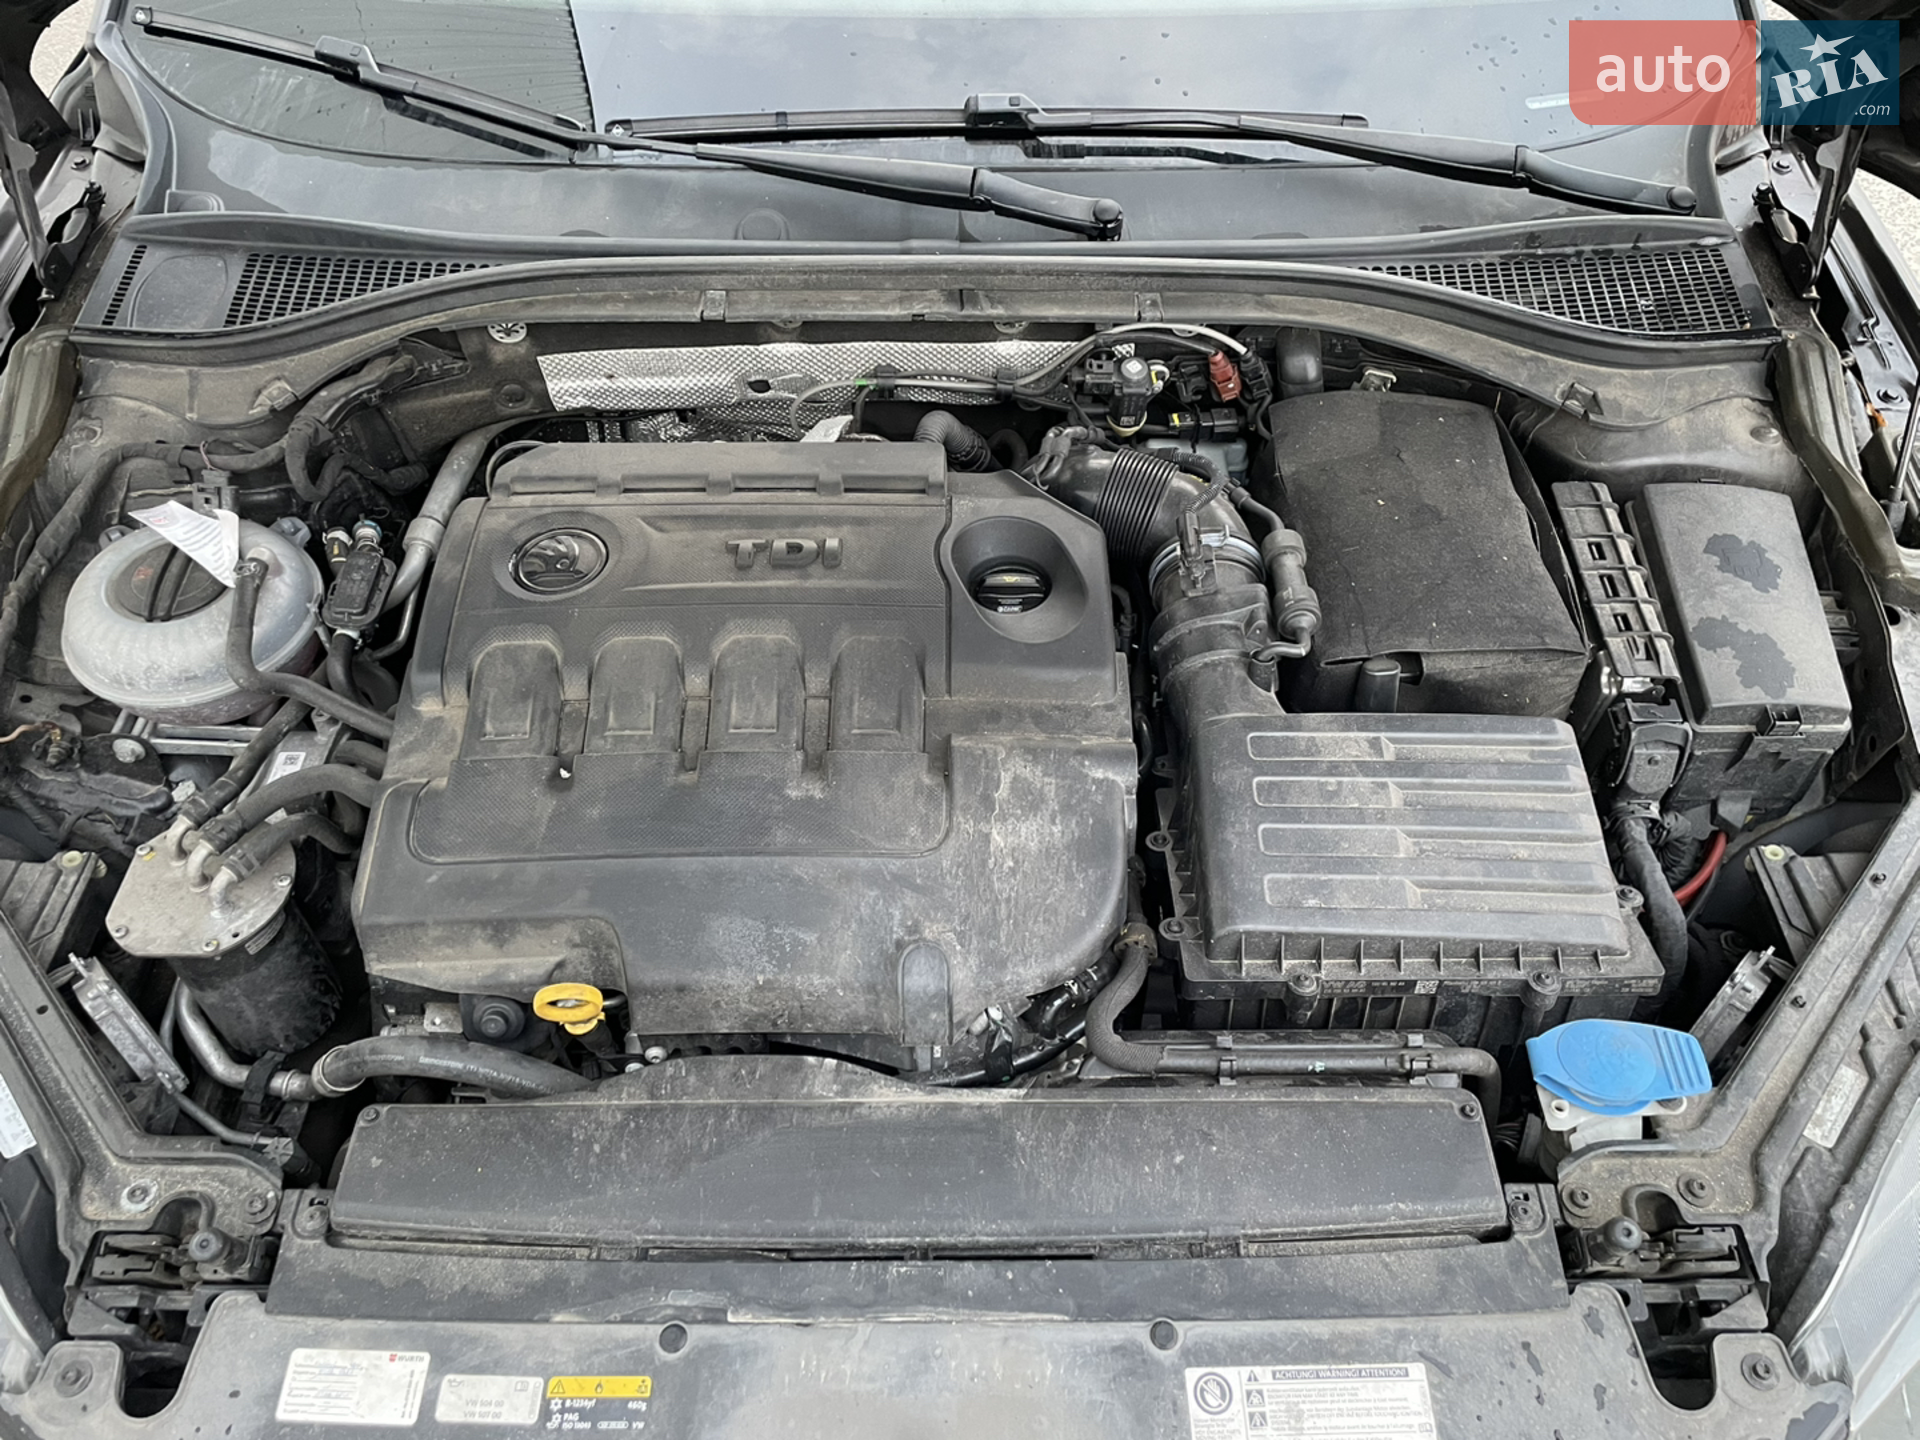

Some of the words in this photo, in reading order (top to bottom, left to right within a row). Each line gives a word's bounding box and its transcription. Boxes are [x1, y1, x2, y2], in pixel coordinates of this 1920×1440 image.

[725, 537, 844, 570] TDI
[1275, 1369, 1317, 1380] ACHTUNG!
[1318, 1368, 1360, 1379] WARNING!
[1361, 1367, 1406, 1378] ATTENTION!
[563, 1412, 580, 1421] PAG
[631, 1421, 645, 1430] VW
